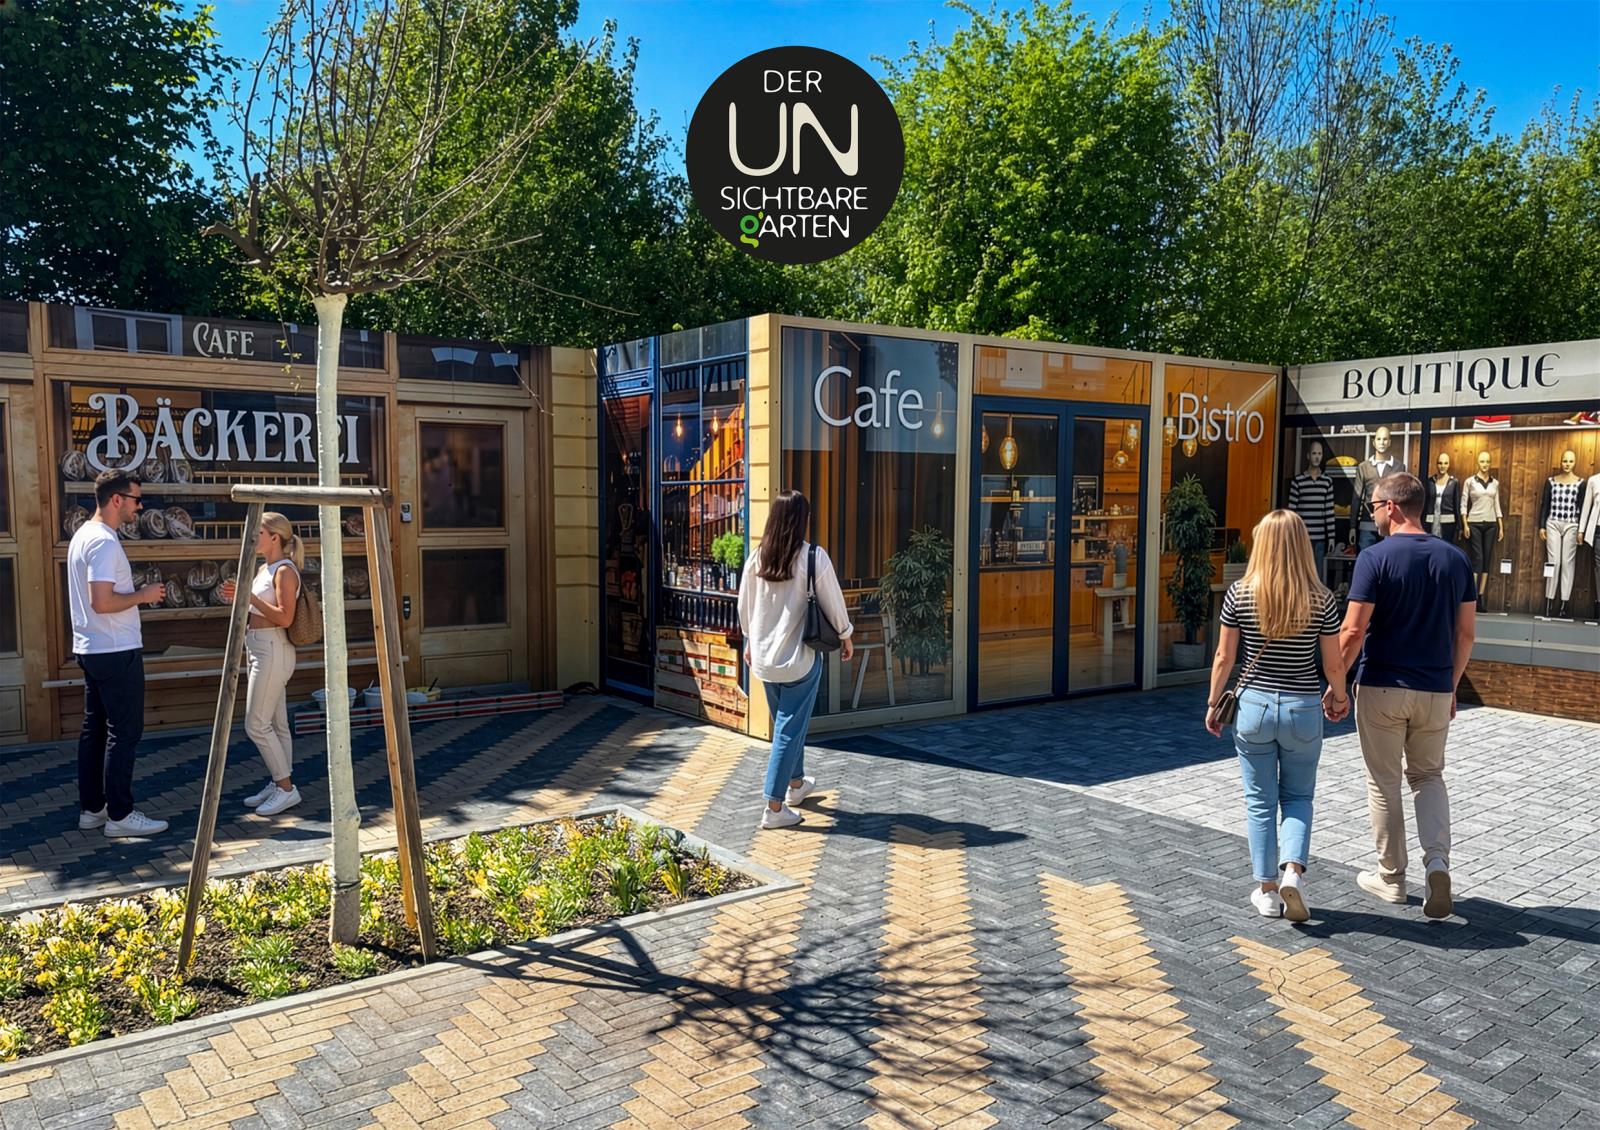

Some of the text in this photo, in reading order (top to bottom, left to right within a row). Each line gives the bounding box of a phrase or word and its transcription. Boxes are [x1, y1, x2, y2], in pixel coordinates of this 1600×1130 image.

[192, 321, 255, 358] CAFE
[813, 364, 925, 431] Cafe
[1342, 352, 1562, 400] BOUTIQUE
[1177, 391, 1266, 445] Bistro
